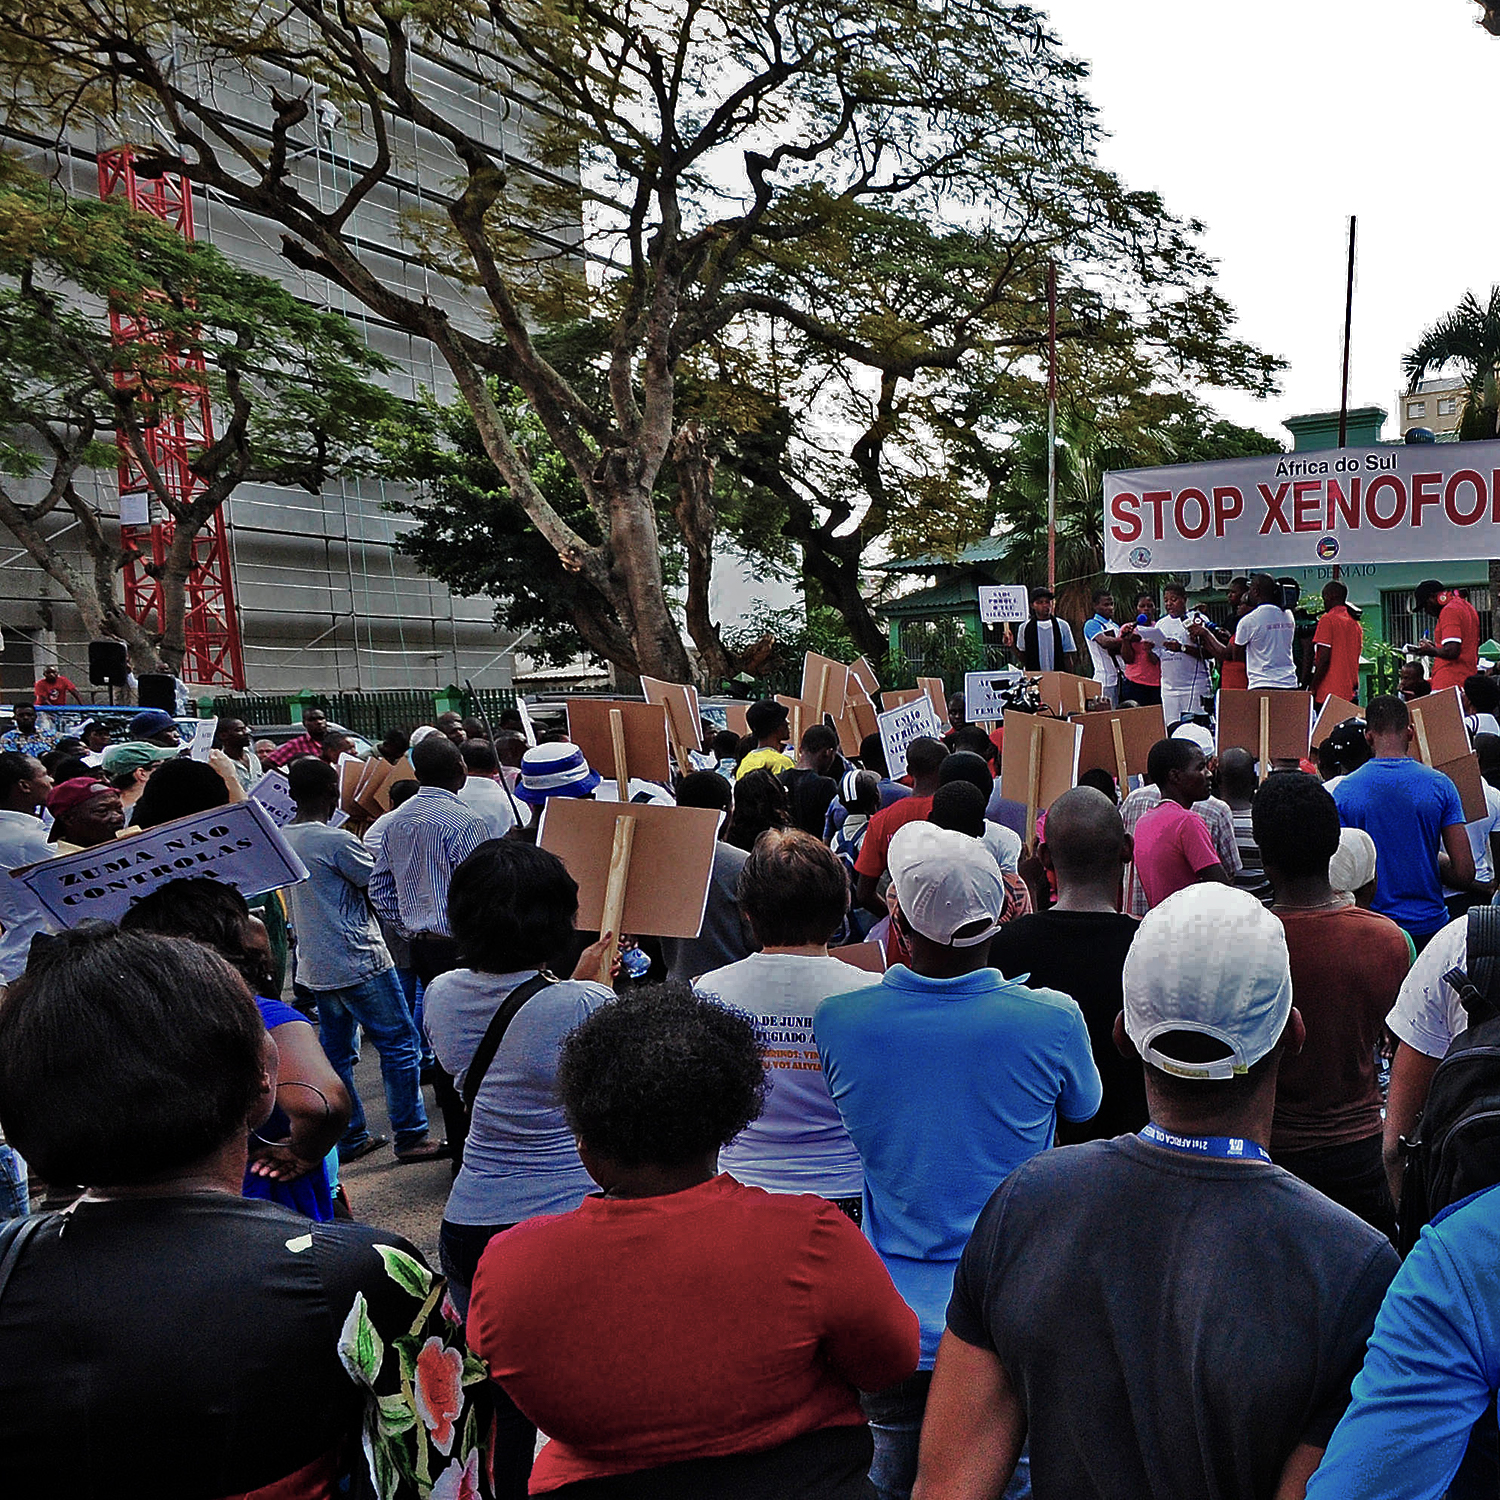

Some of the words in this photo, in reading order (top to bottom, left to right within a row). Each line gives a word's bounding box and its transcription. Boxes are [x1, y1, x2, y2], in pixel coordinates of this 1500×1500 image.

[1275, 457, 1329, 478] África
[1334, 456, 1359, 473] do
[1365, 453, 1397, 472] Sul
[1110, 485, 1244, 543] STOP
[1317, 567, 1333, 580] DE
[1339, 564, 1376, 578] MAIO
[58, 851, 155, 887] ZUMA
[163, 825, 230, 853] NÃO
[62, 837, 253, 906] CONTROLAS
[761, 1016, 778, 1027] DE
[779, 1017, 813, 1028] JUNH
[1165, 1134, 1191, 1149] AFRICA
